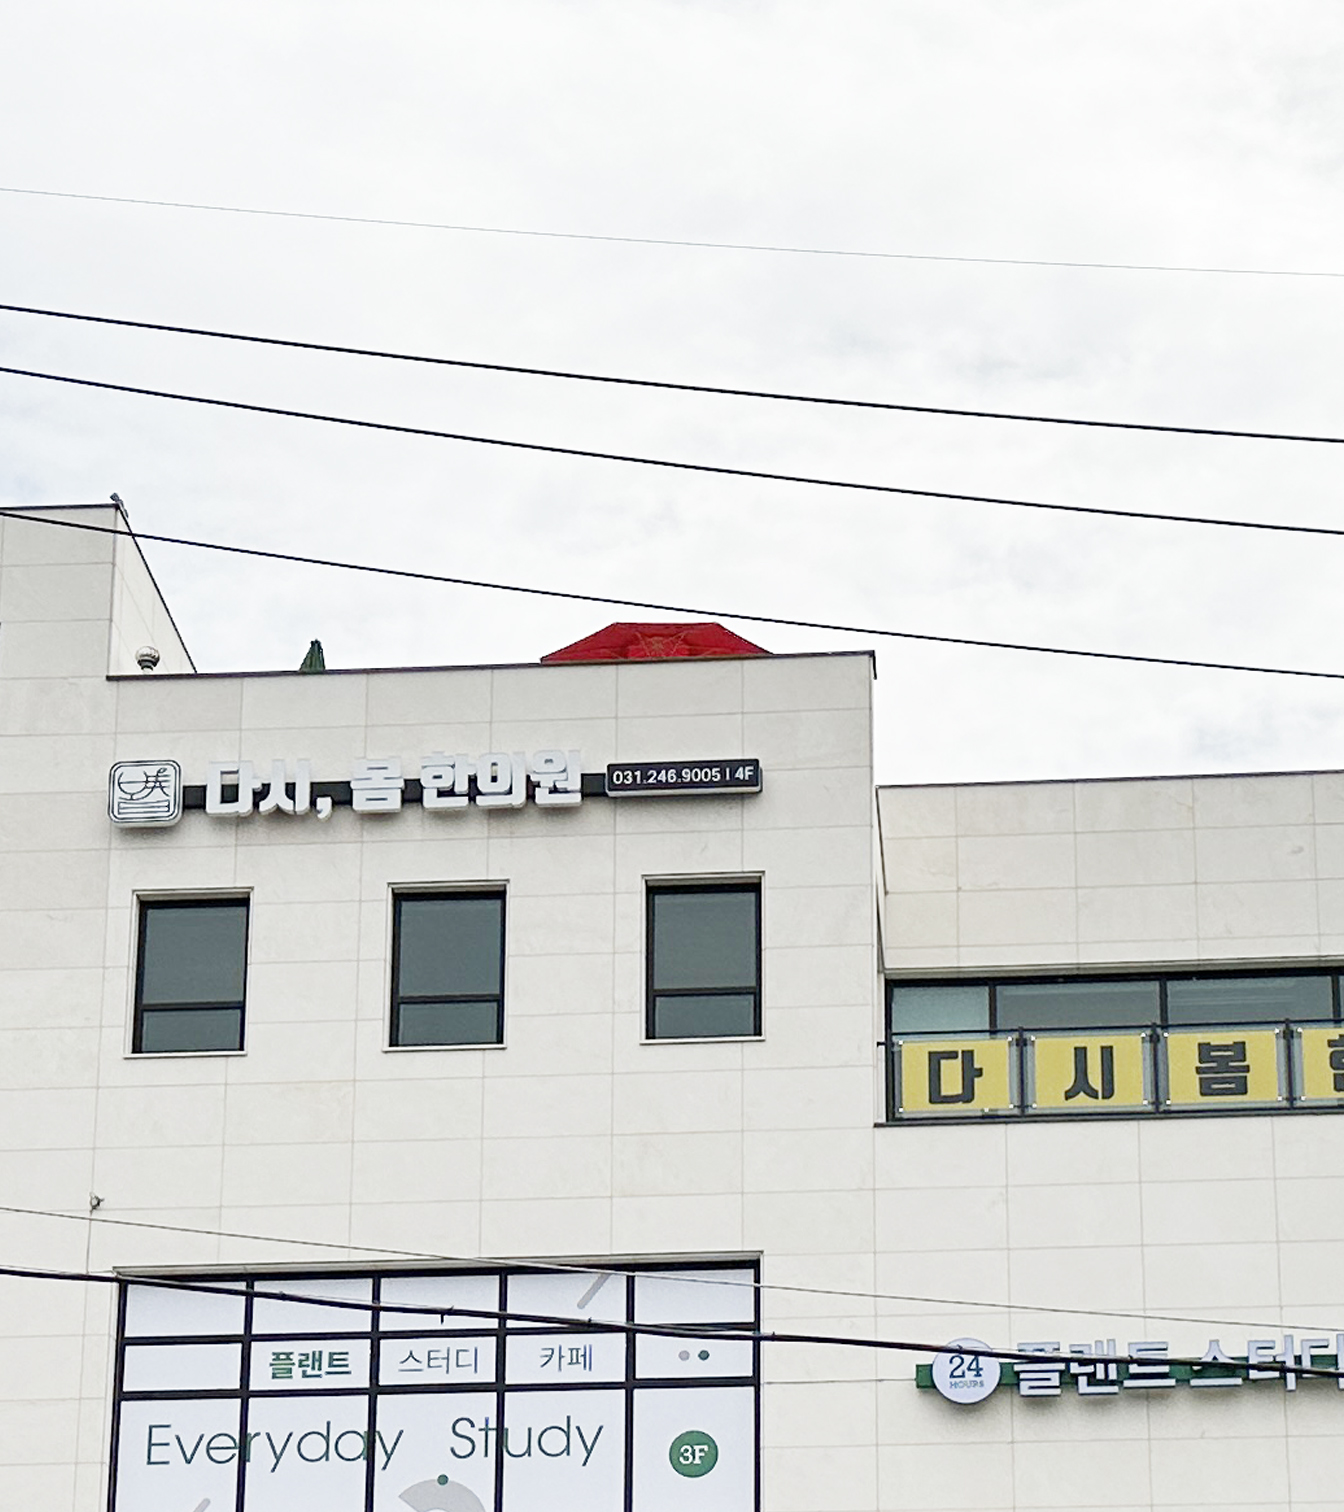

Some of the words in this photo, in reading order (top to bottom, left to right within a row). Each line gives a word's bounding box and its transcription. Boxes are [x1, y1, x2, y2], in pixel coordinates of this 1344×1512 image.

[205, 757, 333, 820] 다시,
[350, 757, 405, 813] 봄
[419, 750, 583, 809] 한의원
[612, 768, 721, 785] 031.246.9005
[735, 765, 754, 781] 4F
[268, 1349, 353, 1381] 플랜트
[397, 1346, 480, 1376] 스터디
[538, 1343, 594, 1373] 카페
[948, 1354, 984, 1379] 24
[145, 1420, 404, 1474] Everyday
[449, 1415, 605, 1467] Study
[678, 1445, 710, 1465] 3F
